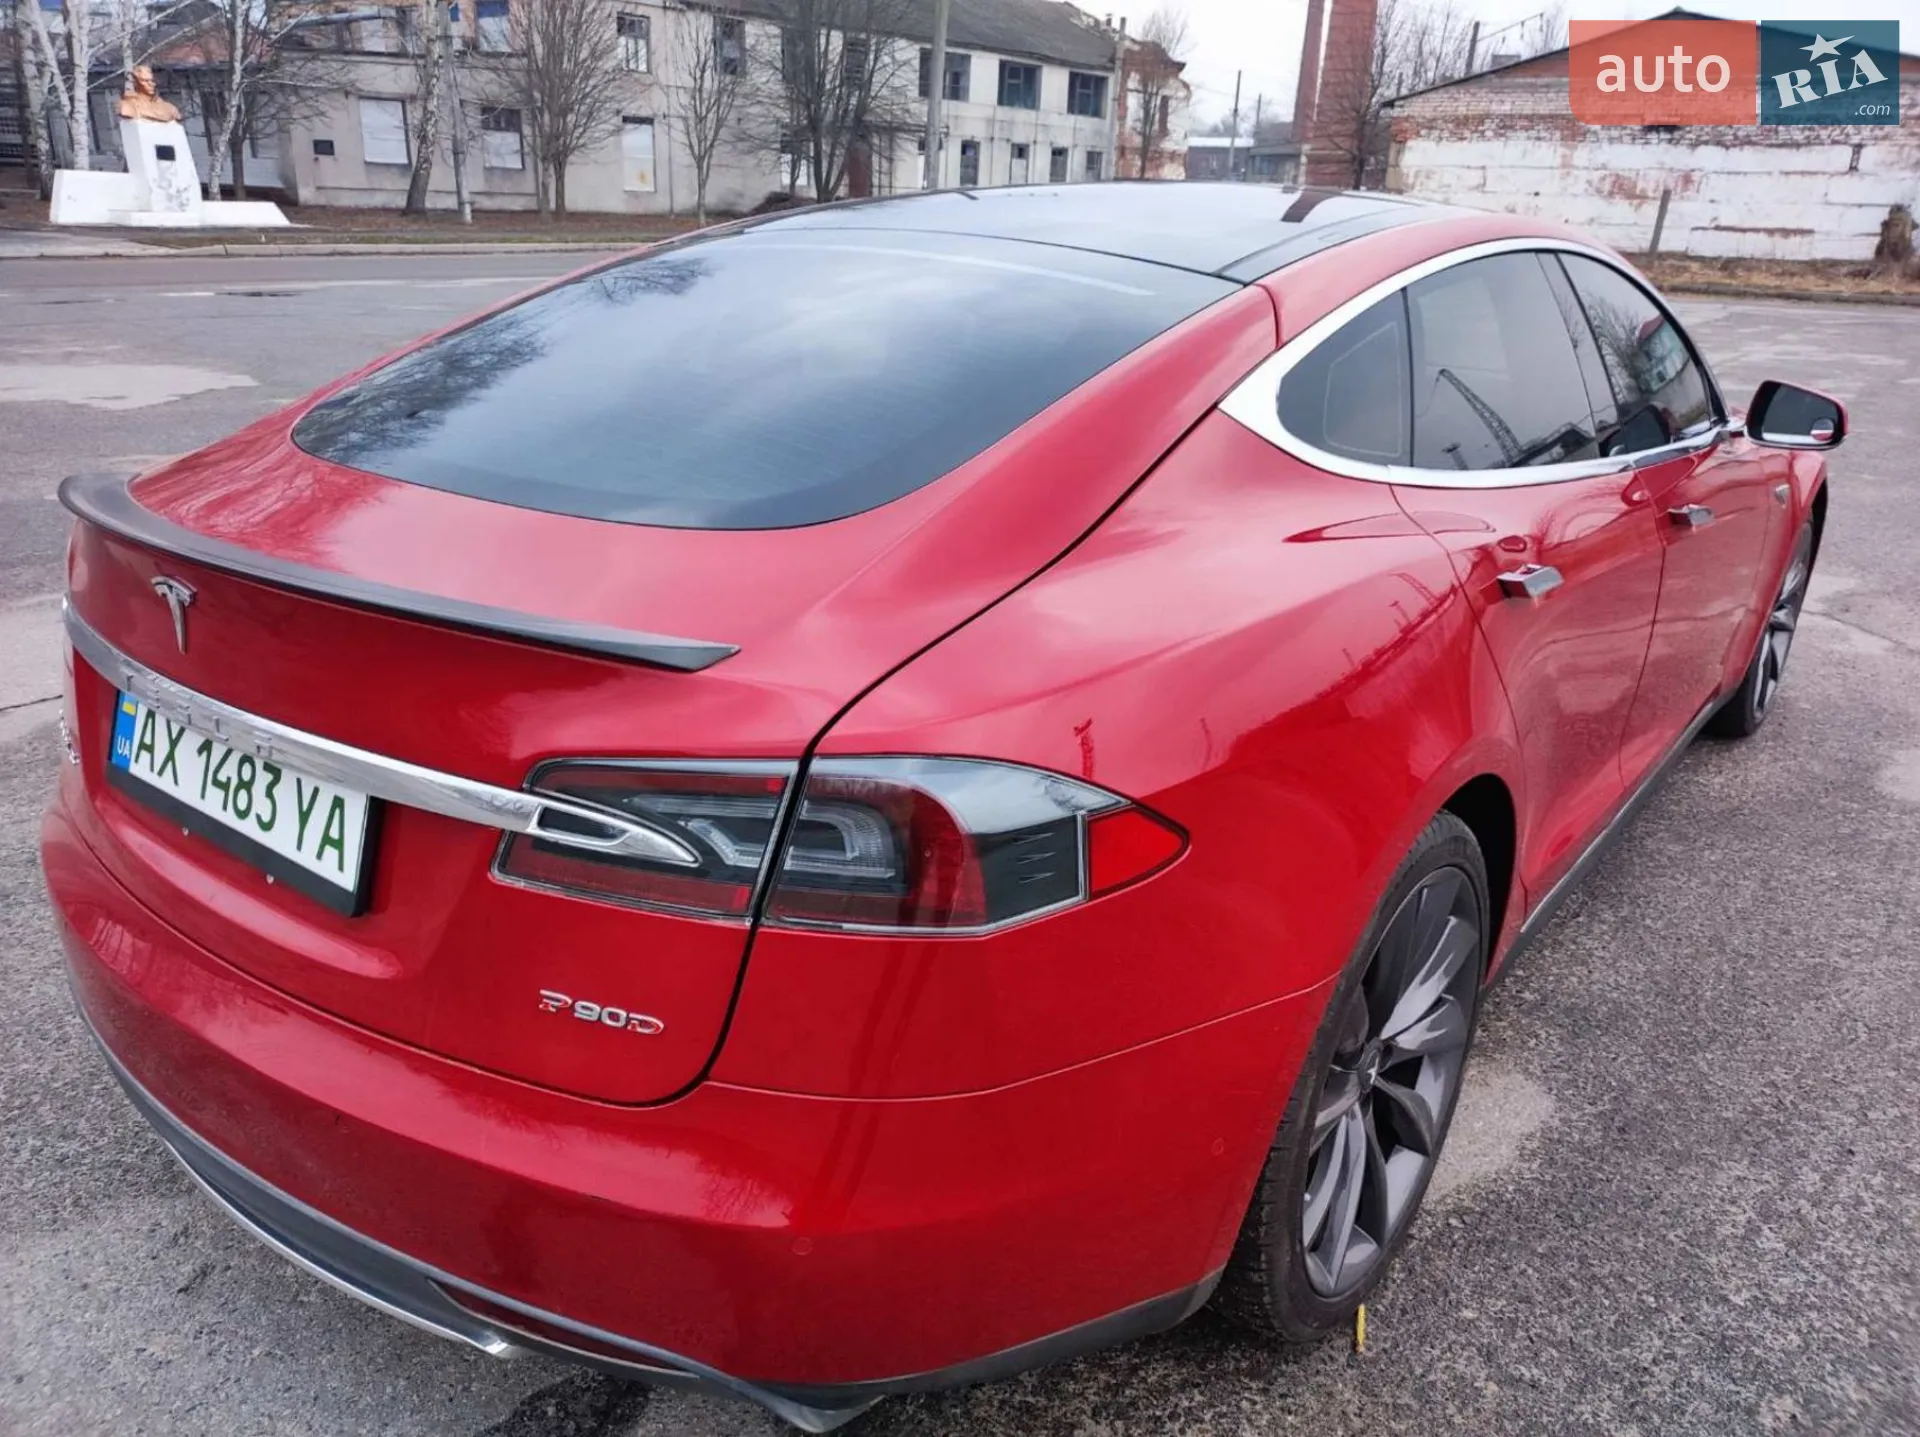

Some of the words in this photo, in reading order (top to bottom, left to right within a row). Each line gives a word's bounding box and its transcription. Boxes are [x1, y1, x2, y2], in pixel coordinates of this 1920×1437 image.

[117, 734, 131, 759] UA
[134, 708, 187, 786] AX
[196, 738, 283, 833] 1483
[296, 777, 346, 874] YA
[538, 988, 665, 1036] P90D
